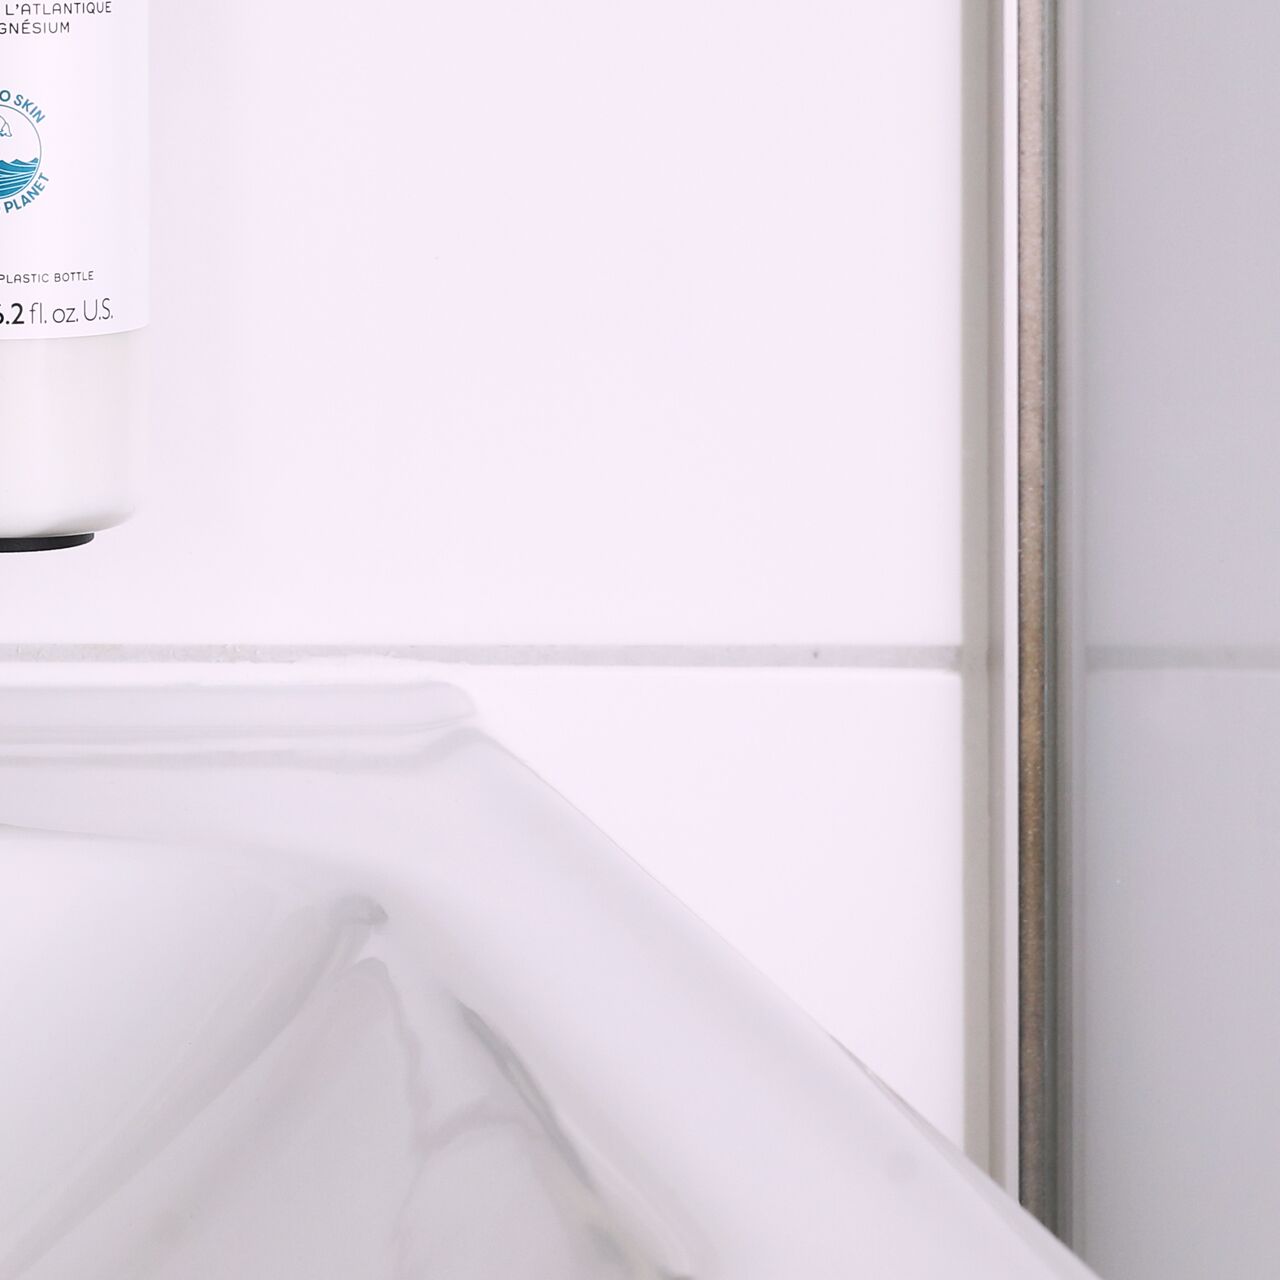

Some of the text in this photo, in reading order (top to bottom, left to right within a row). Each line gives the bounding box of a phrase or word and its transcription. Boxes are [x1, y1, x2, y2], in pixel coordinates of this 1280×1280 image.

[13, 93, 46, 124] SKIN
[4, 172, 50, 214] PLANET
[53, 270, 95, 283] BOTTLE
